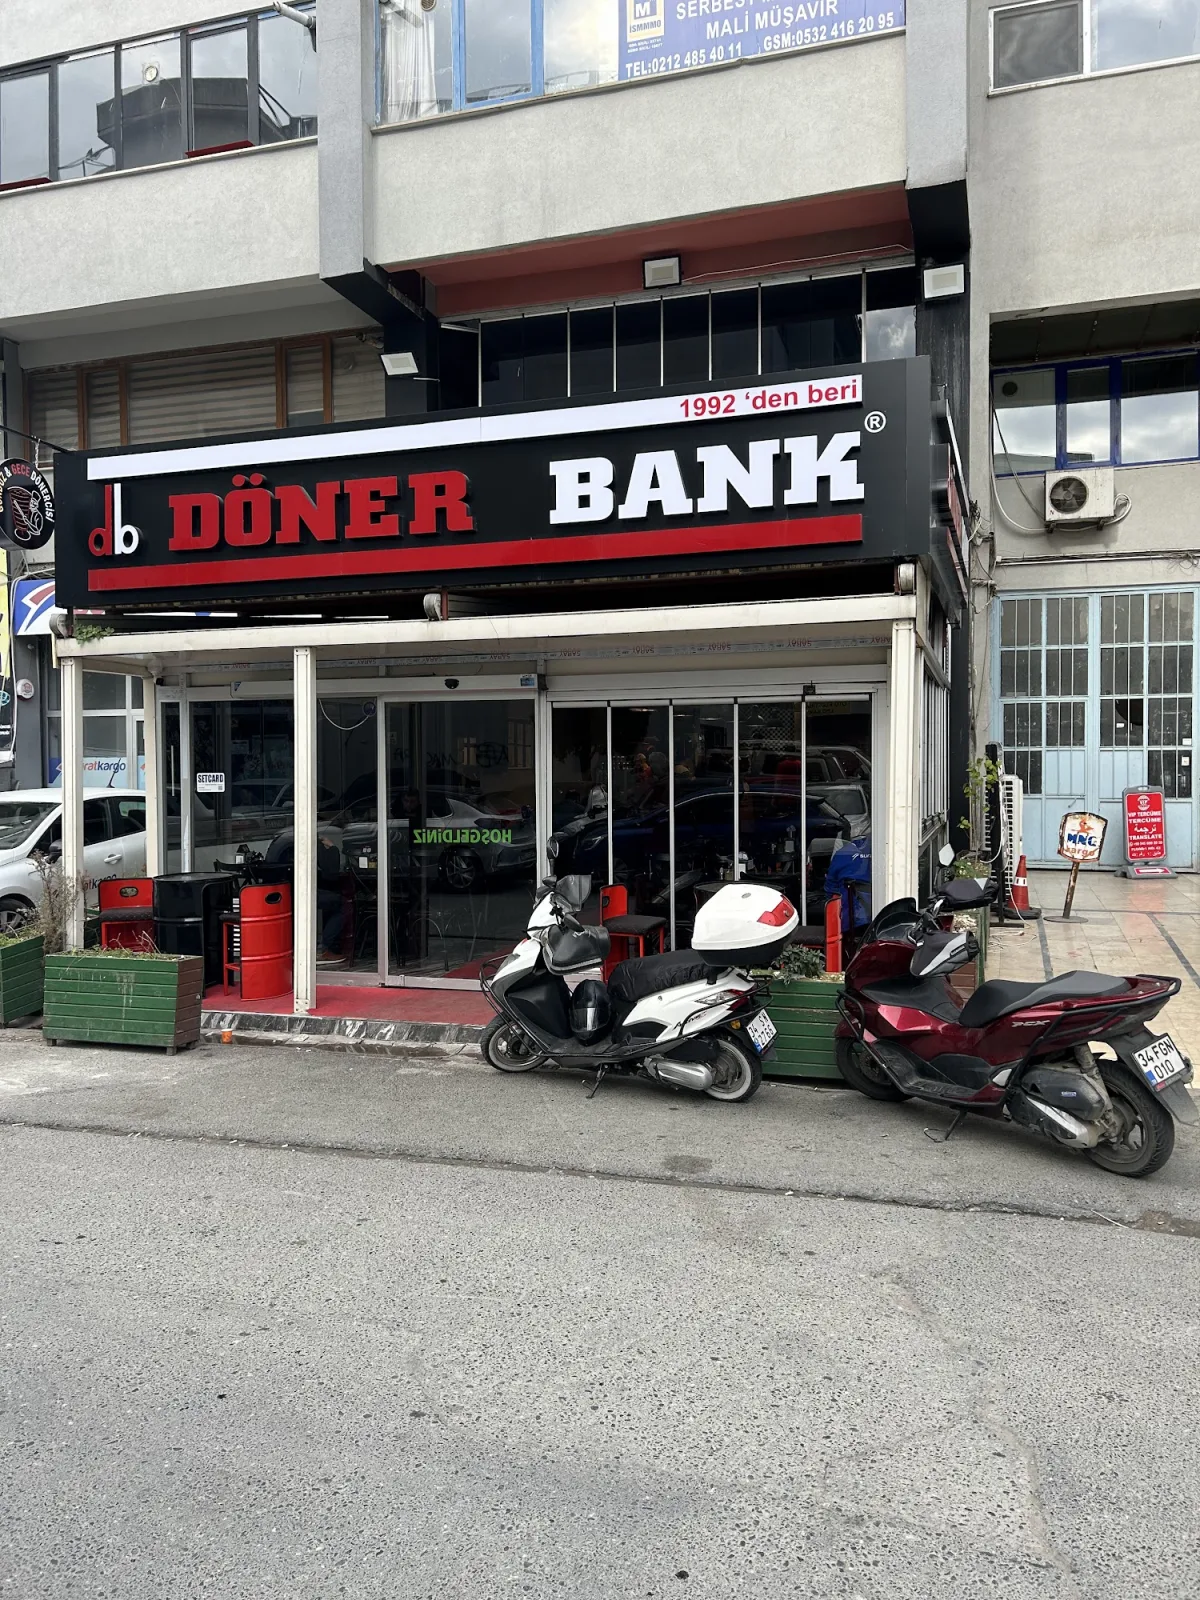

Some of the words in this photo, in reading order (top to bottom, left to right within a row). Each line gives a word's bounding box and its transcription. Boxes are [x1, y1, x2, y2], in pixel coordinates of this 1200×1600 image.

[706, 10, 749, 40] MALİ
[763, 26, 827, 51] GSM:0532
[830, 19, 855, 38] 416
[858, 15, 874, 33] 20
[878, 12, 894, 29] 95
[625, 54, 681, 78] TEL:0212
[684, 49, 706, 67] 485
[710, 45, 724, 62] 40
[728, 41, 742, 58] 11
[680, 394, 736, 418] 1992
[808, 379, 857, 404] beri
[10, 463, 31, 477] GECE
[168, 470, 475, 552] DÖNER
[549, 431, 865, 525] BANK
[870, 634, 892, 644] ARAY
[84, 761, 126, 774] ratkargo
[198, 774, 224, 783] SETCARD
[1011, 1020, 1051, 1028] PCX
[1137, 1050, 1155, 1067] 34
[1151, 1038, 1175, 1059] FGN
[1153, 1059, 1175, 1080] 010
